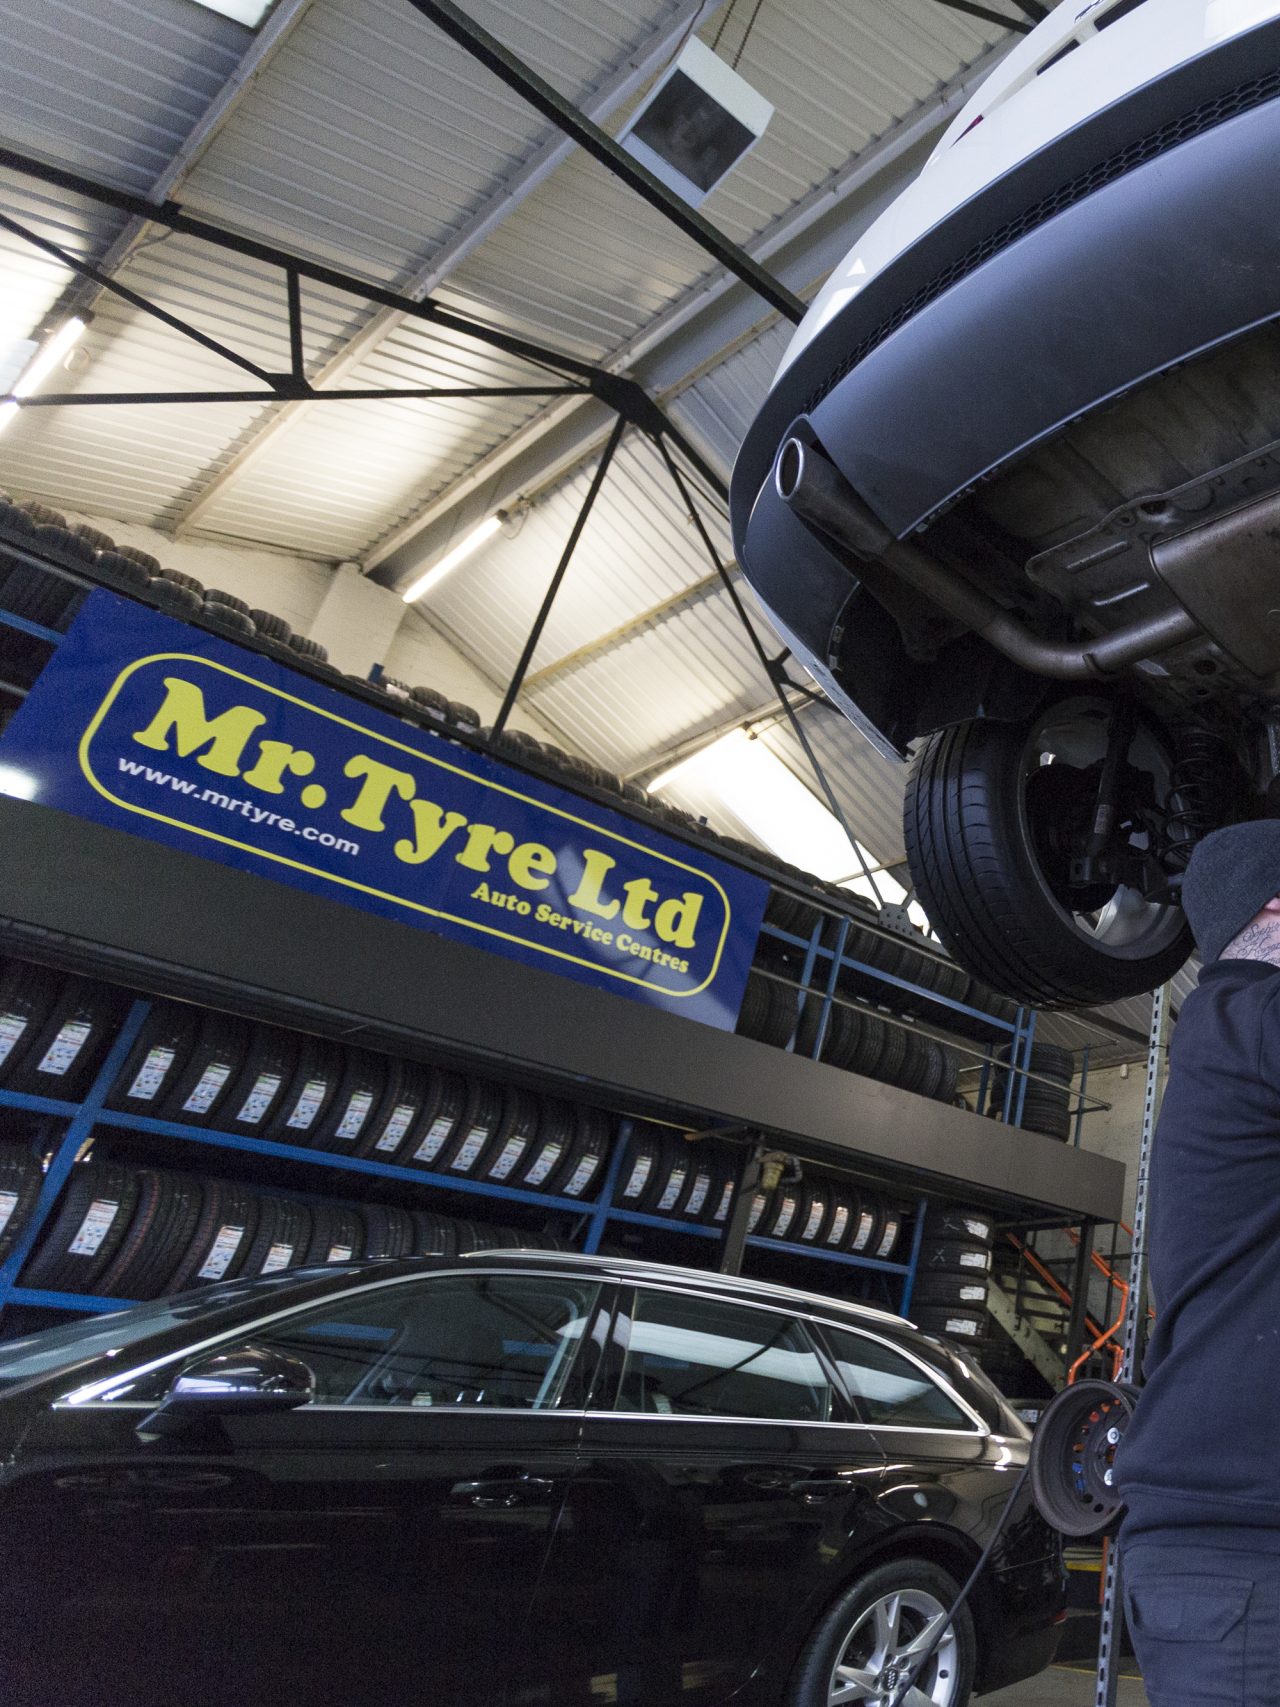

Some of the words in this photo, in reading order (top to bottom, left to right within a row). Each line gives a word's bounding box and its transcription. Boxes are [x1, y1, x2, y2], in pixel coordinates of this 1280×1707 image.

[117, 757, 360, 856] www.mrtyre.com
[133, 678, 327, 808] Mr.
[341, 755, 557, 891] Tyre
[569, 849, 704, 949] Ltd
[470, 882, 532, 916] Auto
[535, 904, 614, 946] Service
[616, 933, 690, 974] Centres
